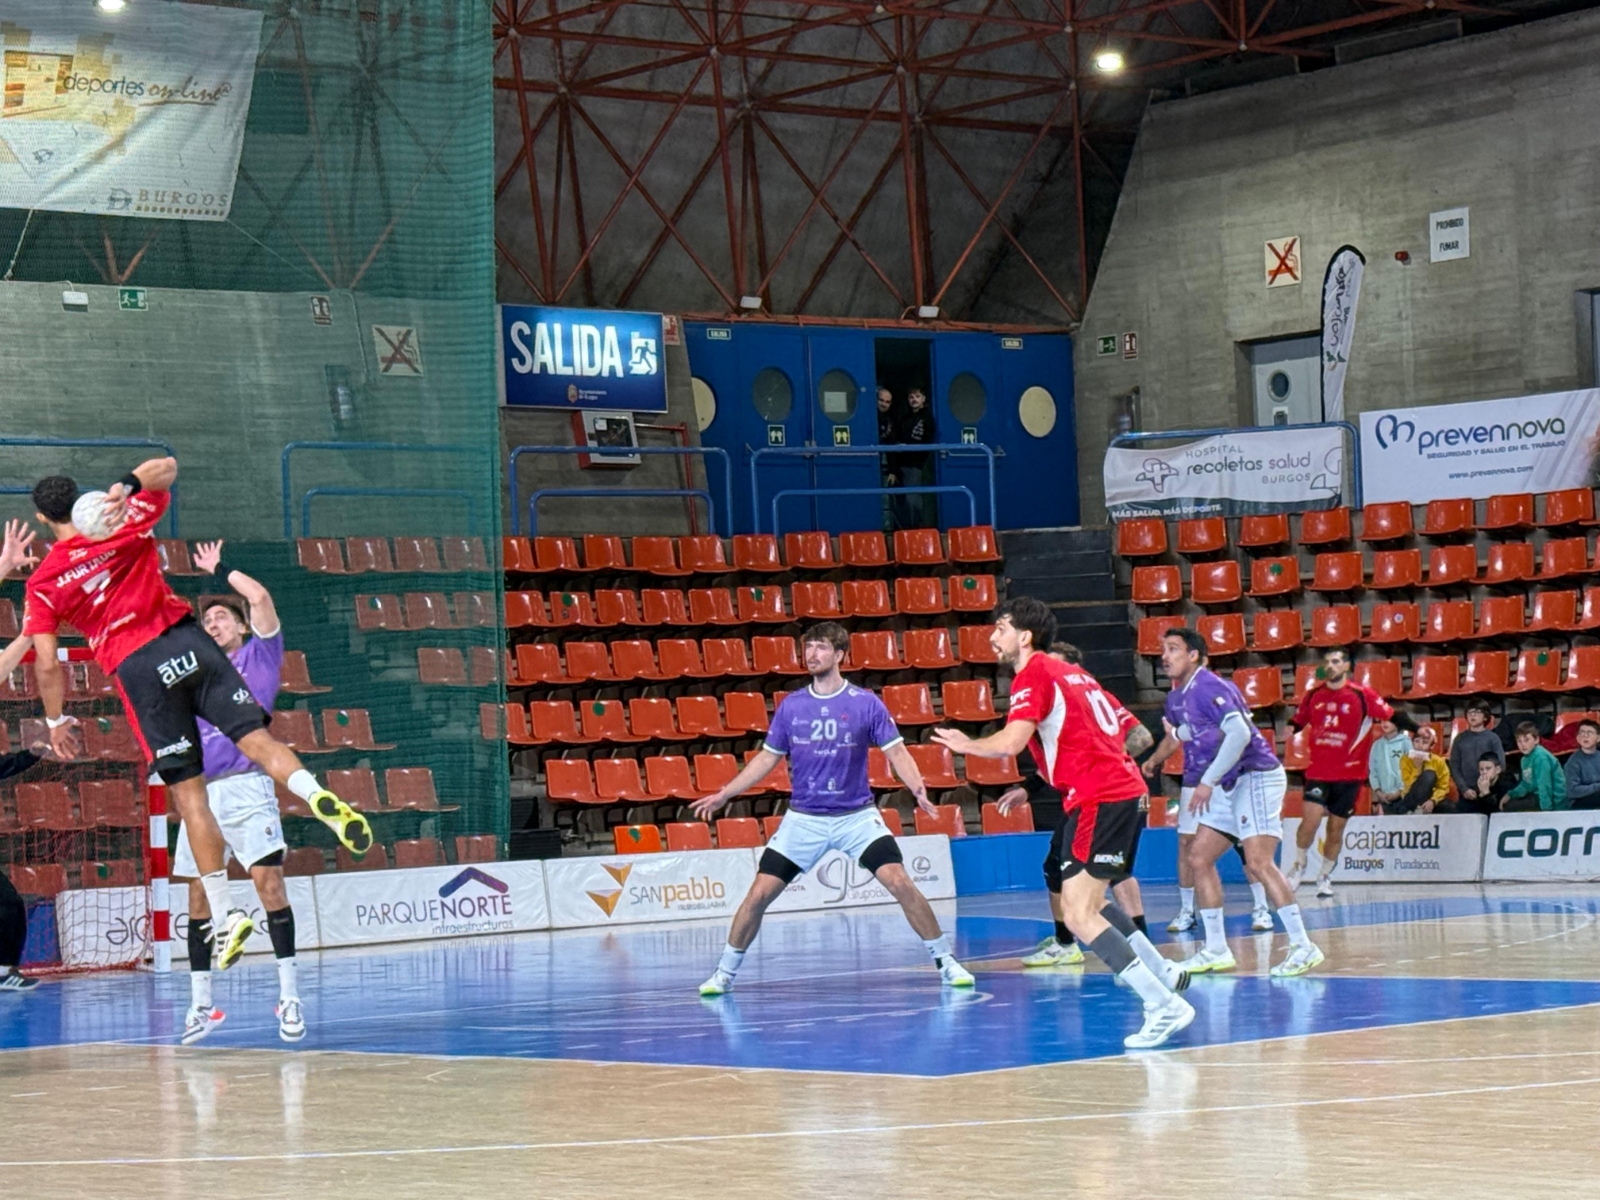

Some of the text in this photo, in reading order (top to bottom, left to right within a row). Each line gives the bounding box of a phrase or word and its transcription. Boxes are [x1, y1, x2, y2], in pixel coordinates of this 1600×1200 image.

[63, 73, 144, 97] deportes
[138, 188, 229, 207] BURGOS
[1439, 240, 1460, 253] FUMAR
[510, 320, 624, 378] SALIDA
[1418, 417, 1566, 456] prevennova
[1185, 445, 1244, 459] HOSPITAL
[1426, 450, 1472, 460] SEGURIDAD
[1473, 448, 1479, 456] Y
[1480, 446, 1506, 455] SALUD
[1520, 443, 1530, 451] EL
[1531, 440, 1566, 450] TRABAJO
[1187, 452, 1311, 476] recoletas salud
[1261, 473, 1311, 485] BURGOS
[1112, 509, 1131, 518] MÁS
[1163, 506, 1181, 516] MÁS
[81, 568, 111, 607] 7
[810, 718, 838, 741] 20
[1324, 714, 1339, 727] 24
[1345, 824, 1440, 856] cajarural
[1344, 857, 1440, 872] Burgos Fundación
[629, 875, 726, 909] SANpablo
[356, 893, 513, 926] PARQUENORTE
[430, 919, 514, 935] infraestructuras
